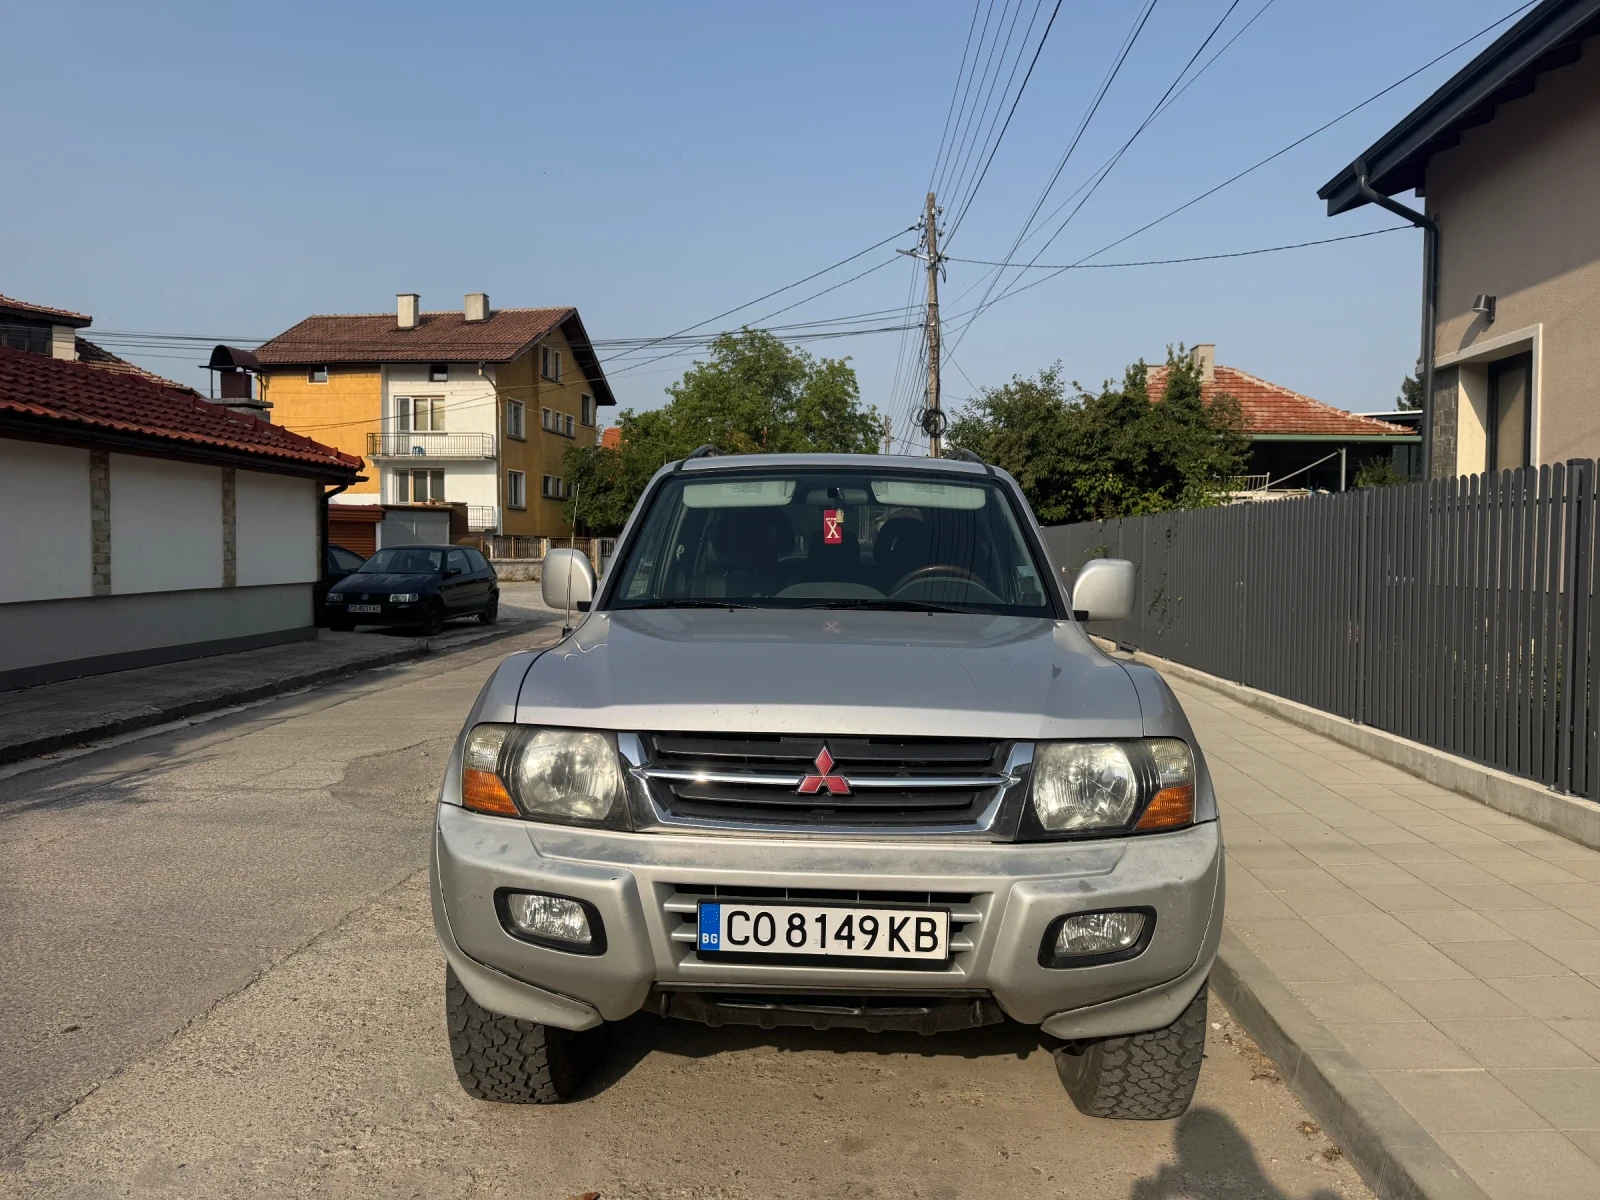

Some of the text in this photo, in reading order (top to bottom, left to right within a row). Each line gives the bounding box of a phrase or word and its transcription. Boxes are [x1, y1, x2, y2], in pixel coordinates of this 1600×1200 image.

[702, 933, 718, 944] BG
[727, 910, 939, 953] CO 8149 KB
